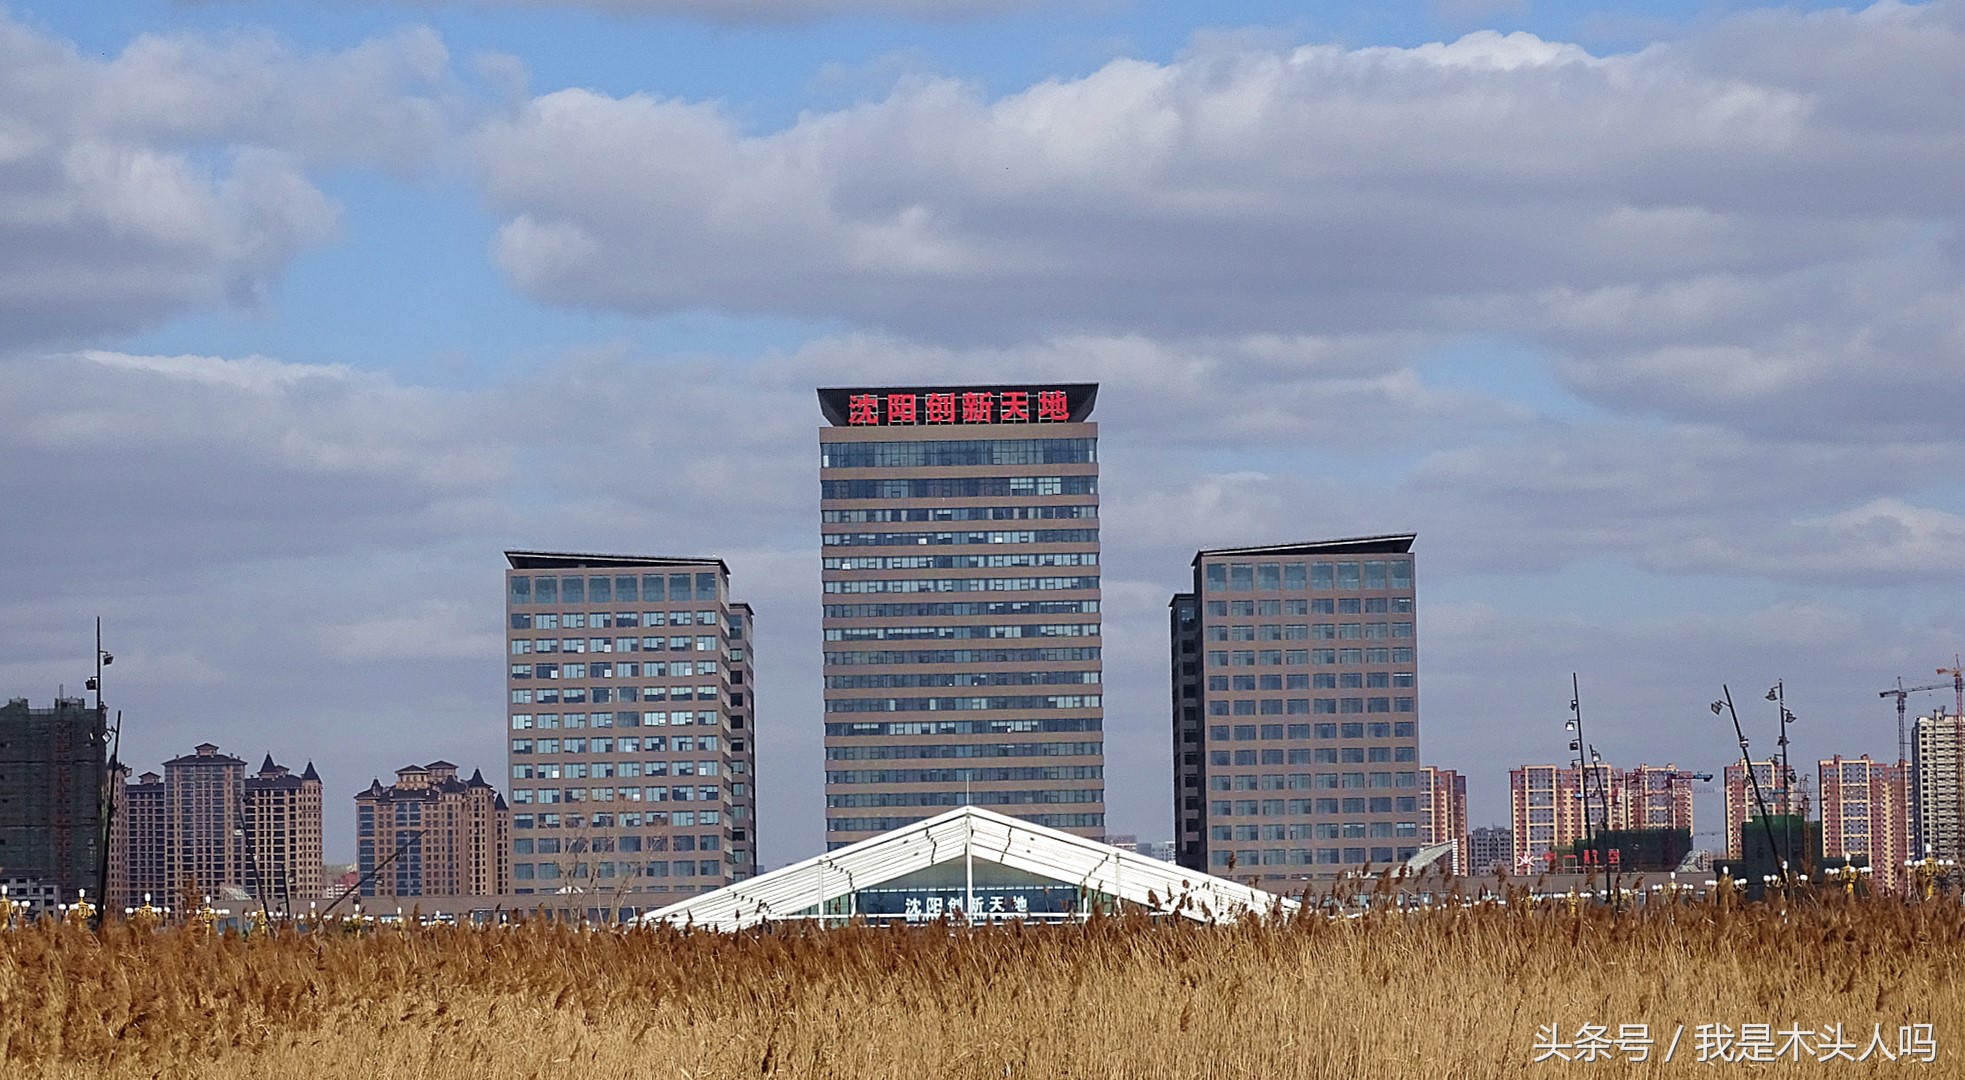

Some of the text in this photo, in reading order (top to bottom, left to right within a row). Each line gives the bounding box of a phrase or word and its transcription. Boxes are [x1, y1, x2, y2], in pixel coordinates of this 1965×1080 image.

[848, 390, 1070, 424] 沈阳创新天地
[905, 895, 1028, 915] 沈阳创新天地
